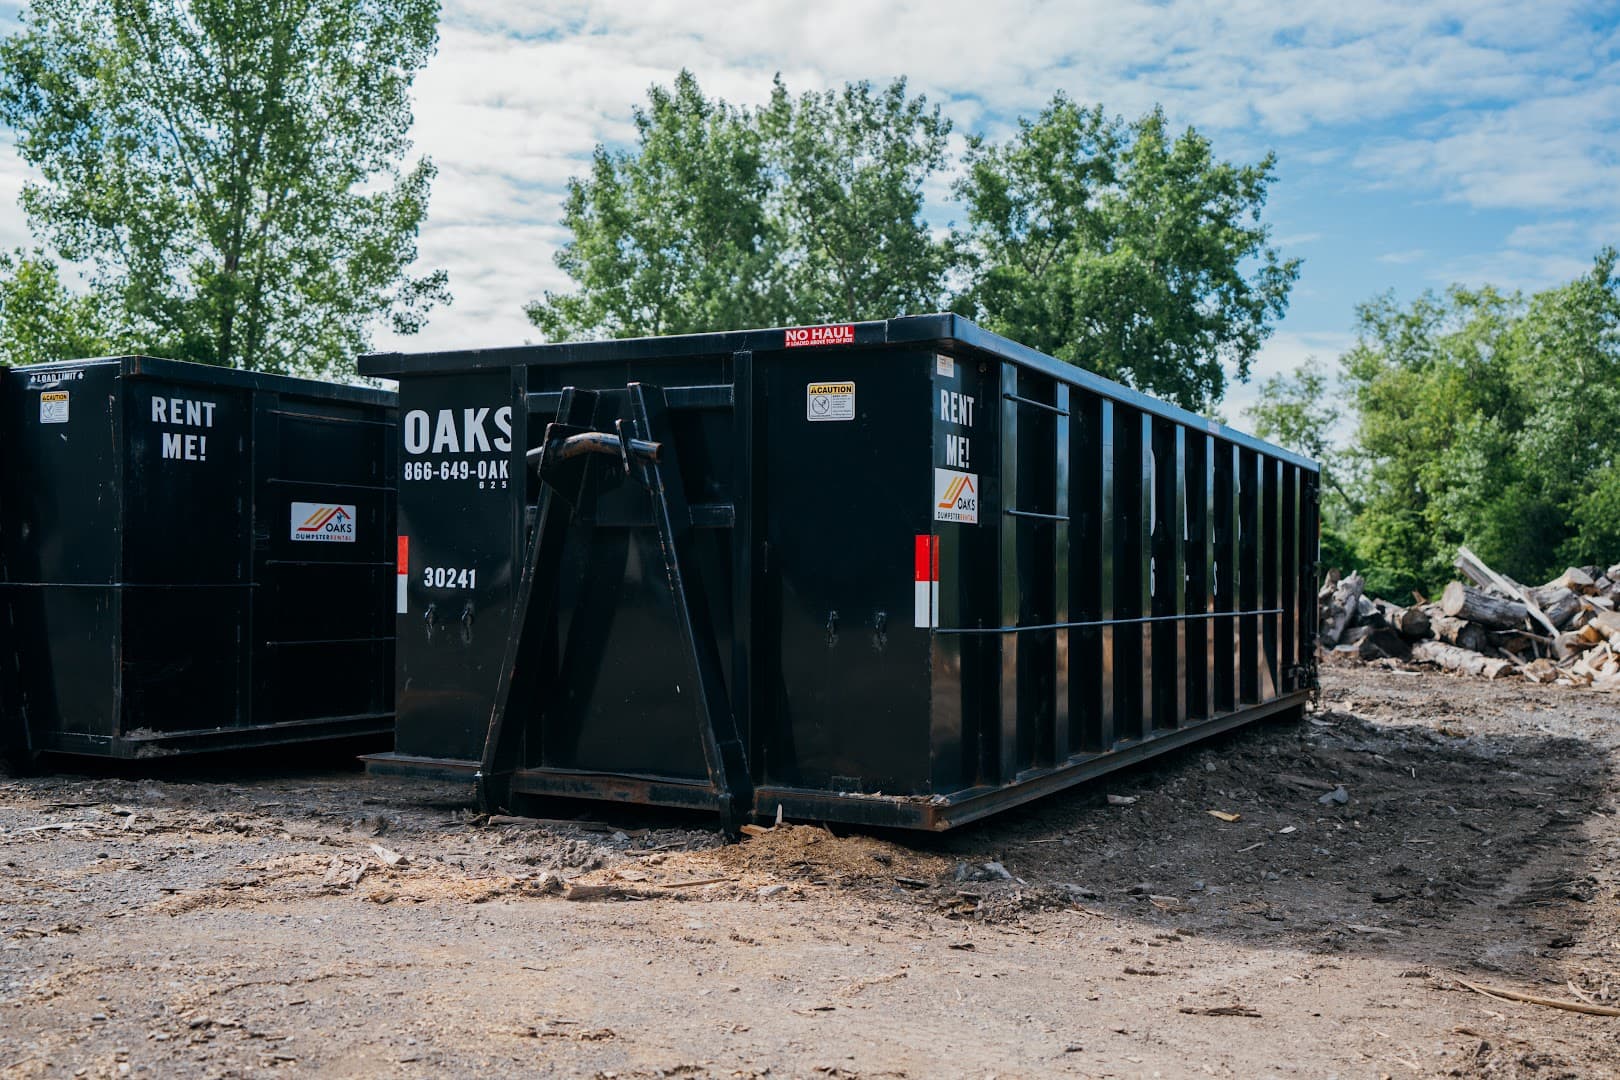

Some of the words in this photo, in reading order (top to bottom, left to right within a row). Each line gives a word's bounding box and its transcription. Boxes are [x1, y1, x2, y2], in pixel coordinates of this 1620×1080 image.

[786, 330, 808, 341] NO
[812, 327, 853, 339] HAUL
[37, 373, 57, 383] LOAD
[58, 372, 76, 381] LIMIT
[817, 386, 852, 394] CAUTION
[151, 395, 216, 428] RENT
[940, 389, 975, 428] RENT
[404, 406, 512, 455] OAKS
[162, 432, 206, 462] ME!
[946, 433, 970, 469] ME!
[404, 459, 509, 481] 866-649-OAK
[957, 497, 976, 511] OAKS
[325, 522, 352, 533] OAKS
[423, 566, 476, 589] 30241
